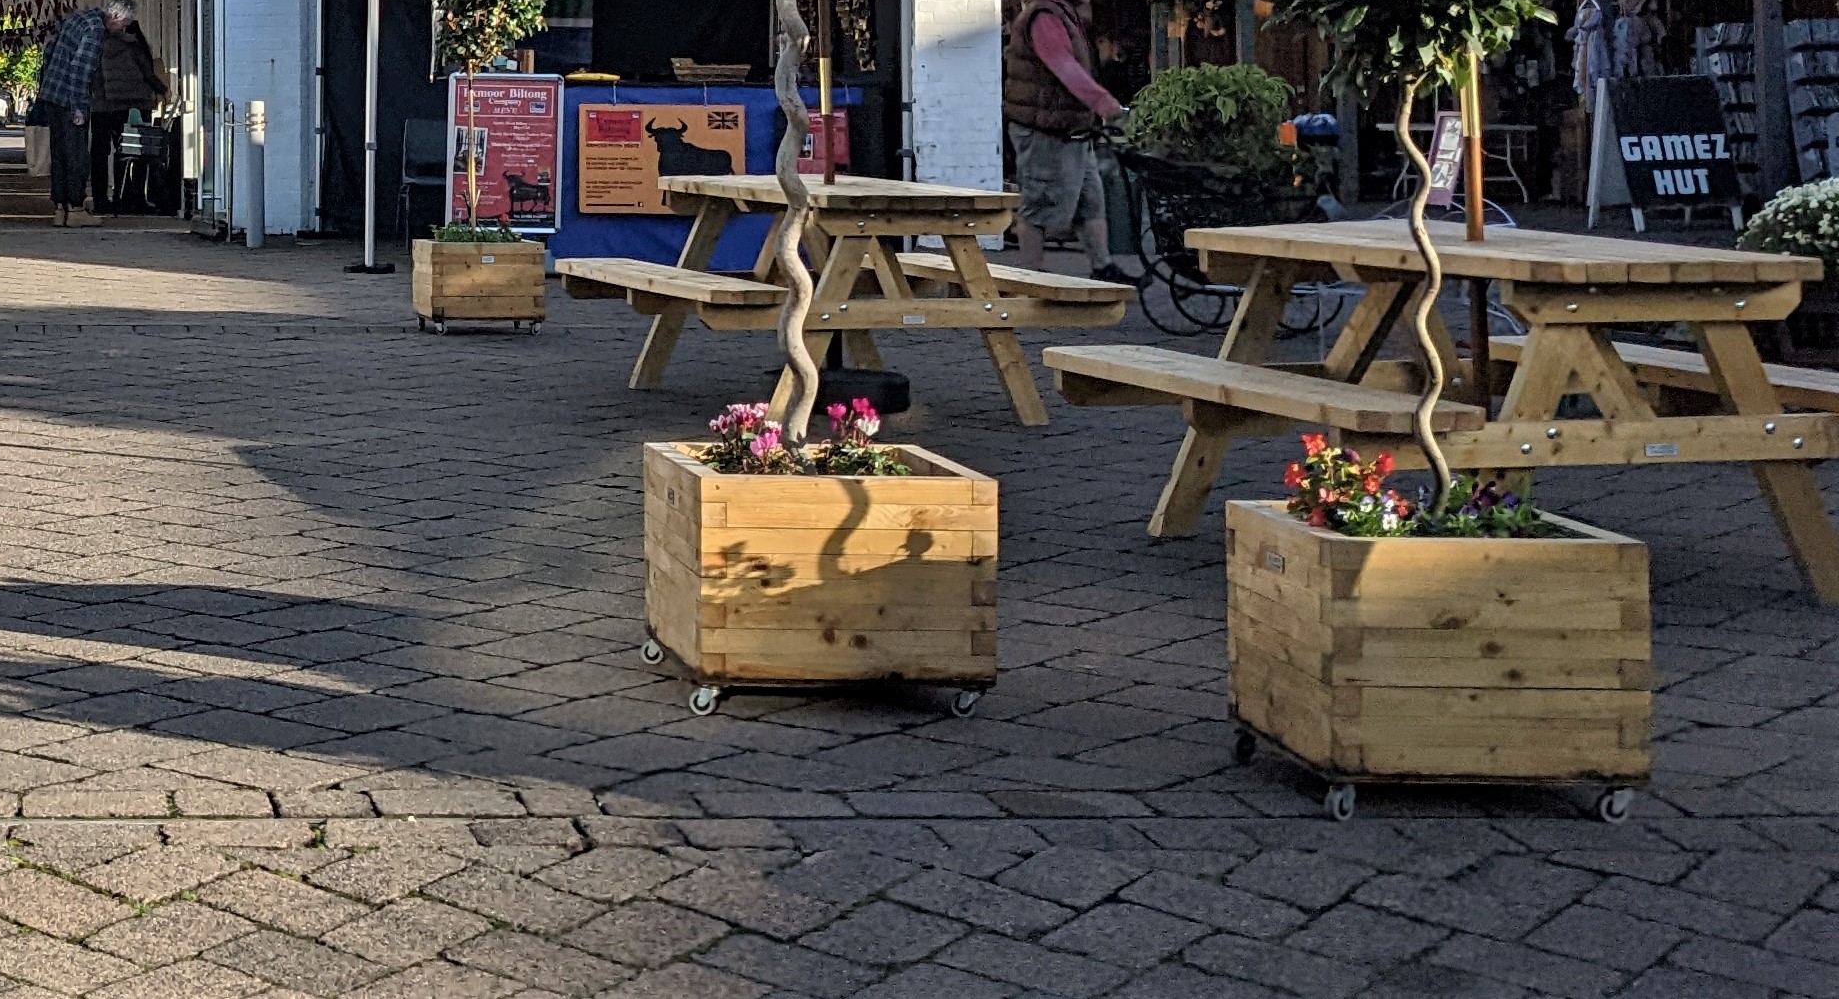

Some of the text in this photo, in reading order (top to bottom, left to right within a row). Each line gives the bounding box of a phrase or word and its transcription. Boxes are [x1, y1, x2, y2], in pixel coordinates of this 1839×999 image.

[509, 88, 548, 101] Biltong
[1620, 133, 1731, 161] GAMEZ
[1653, 168, 1710, 195] HUT
